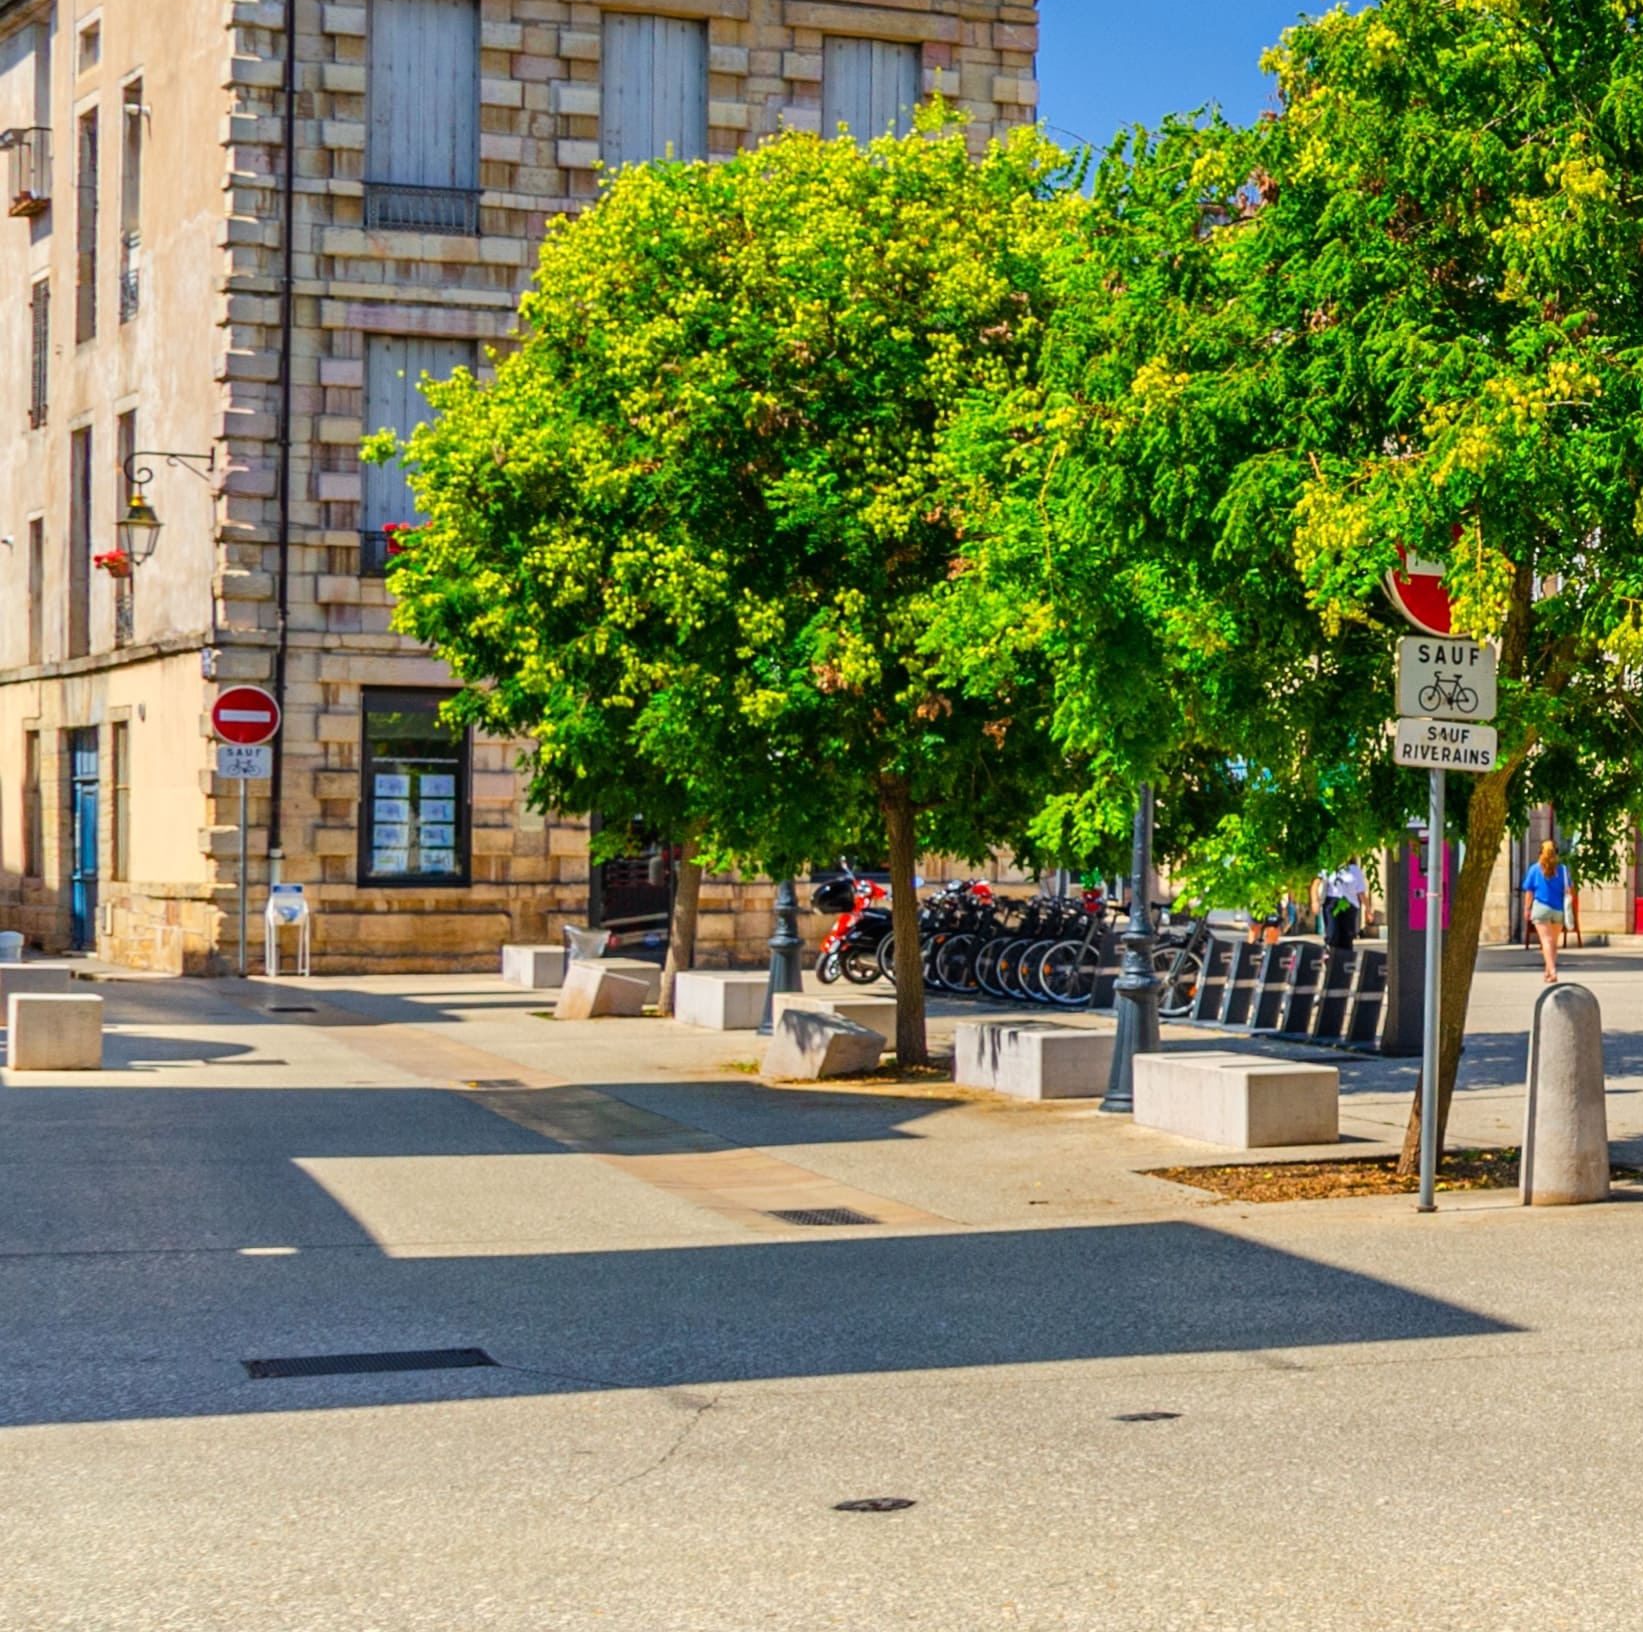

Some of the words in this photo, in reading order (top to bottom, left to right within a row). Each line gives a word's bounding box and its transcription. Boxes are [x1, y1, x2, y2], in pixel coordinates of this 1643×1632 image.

[1418, 644, 1480, 666] SAUF
[1427, 726, 1470, 744] SAUF
[1402, 743, 1490, 765] RIVERAINS
